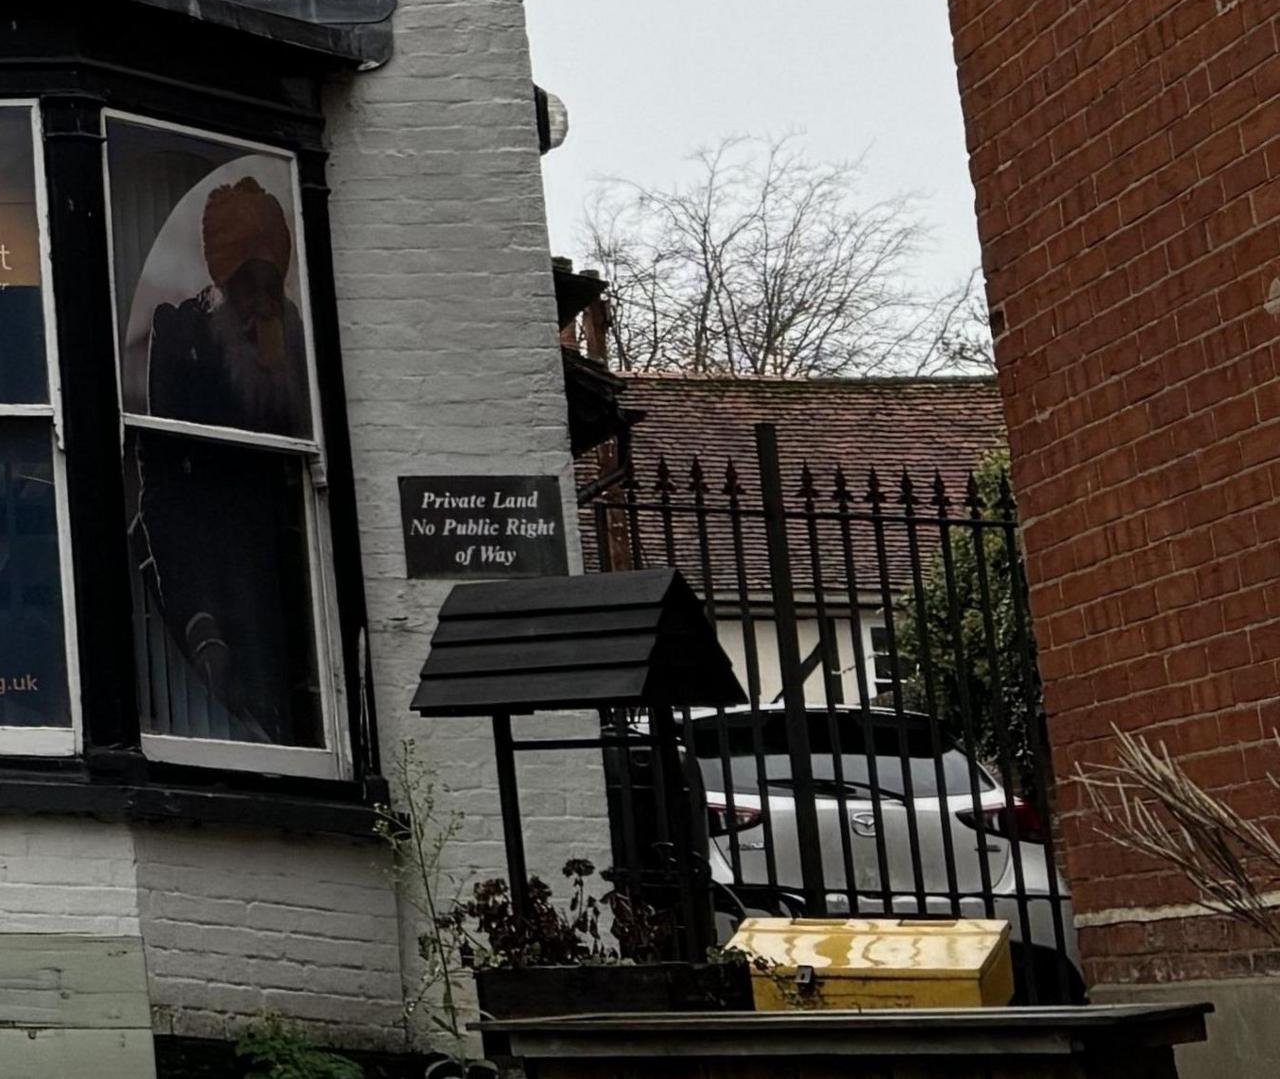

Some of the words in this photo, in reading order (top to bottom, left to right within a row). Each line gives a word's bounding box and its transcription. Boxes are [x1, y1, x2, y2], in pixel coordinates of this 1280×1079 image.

[421, 492, 486, 509] Private
[493, 490, 538, 509] Land
[410, 518, 435, 536] No
[442, 518, 499, 536] Public
[505, 518, 555, 539] Right
[455, 545, 476, 566] of
[480, 545, 516, 566] Way
